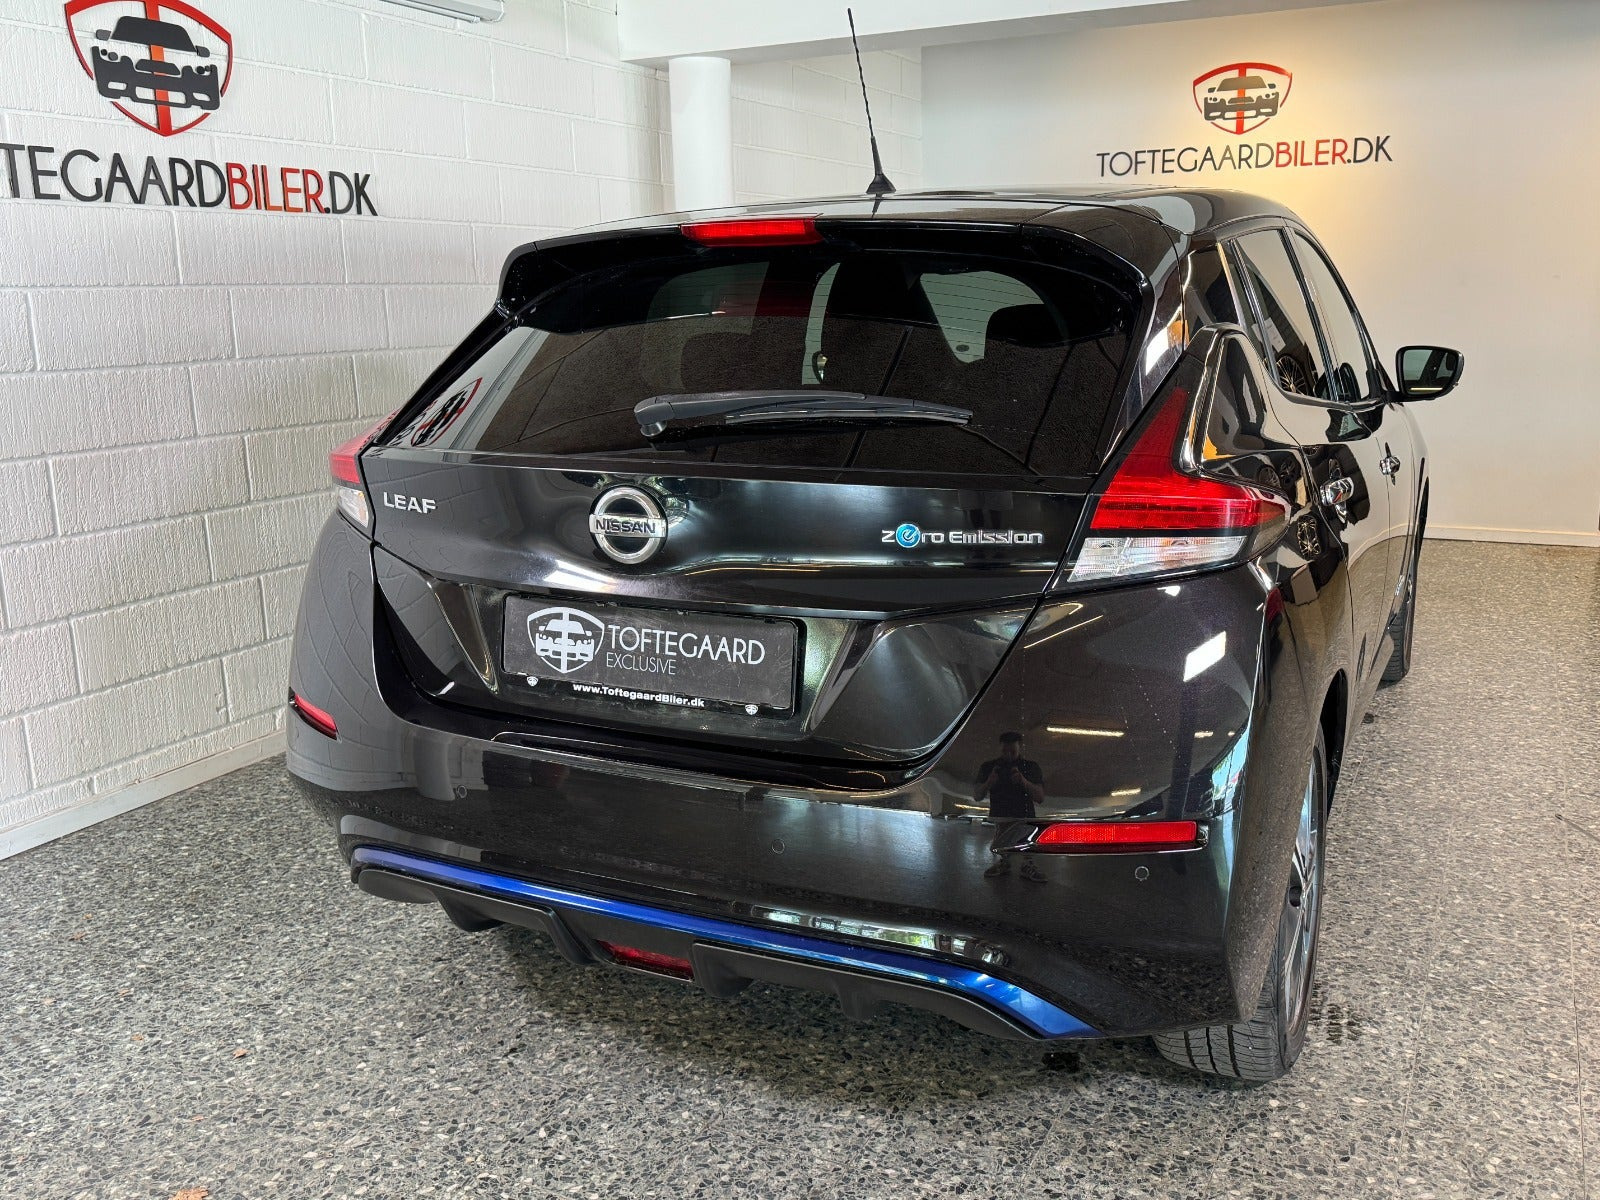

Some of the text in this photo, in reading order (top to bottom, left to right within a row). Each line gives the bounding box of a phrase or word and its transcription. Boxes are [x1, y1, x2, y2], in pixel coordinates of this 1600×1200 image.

[1096, 135, 1393, 177] TOFTEGAARDBILER.DK
[383, 491, 437, 514] LEAF
[595, 517, 656, 534] NISSAN
[949, 529, 1043, 545] Emission
[607, 624, 766, 665] TOFTEGAARD
[606, 652, 677, 676] EXCLUSIVE
[573, 683, 705, 708] www.ToftegaardBiler.dk
